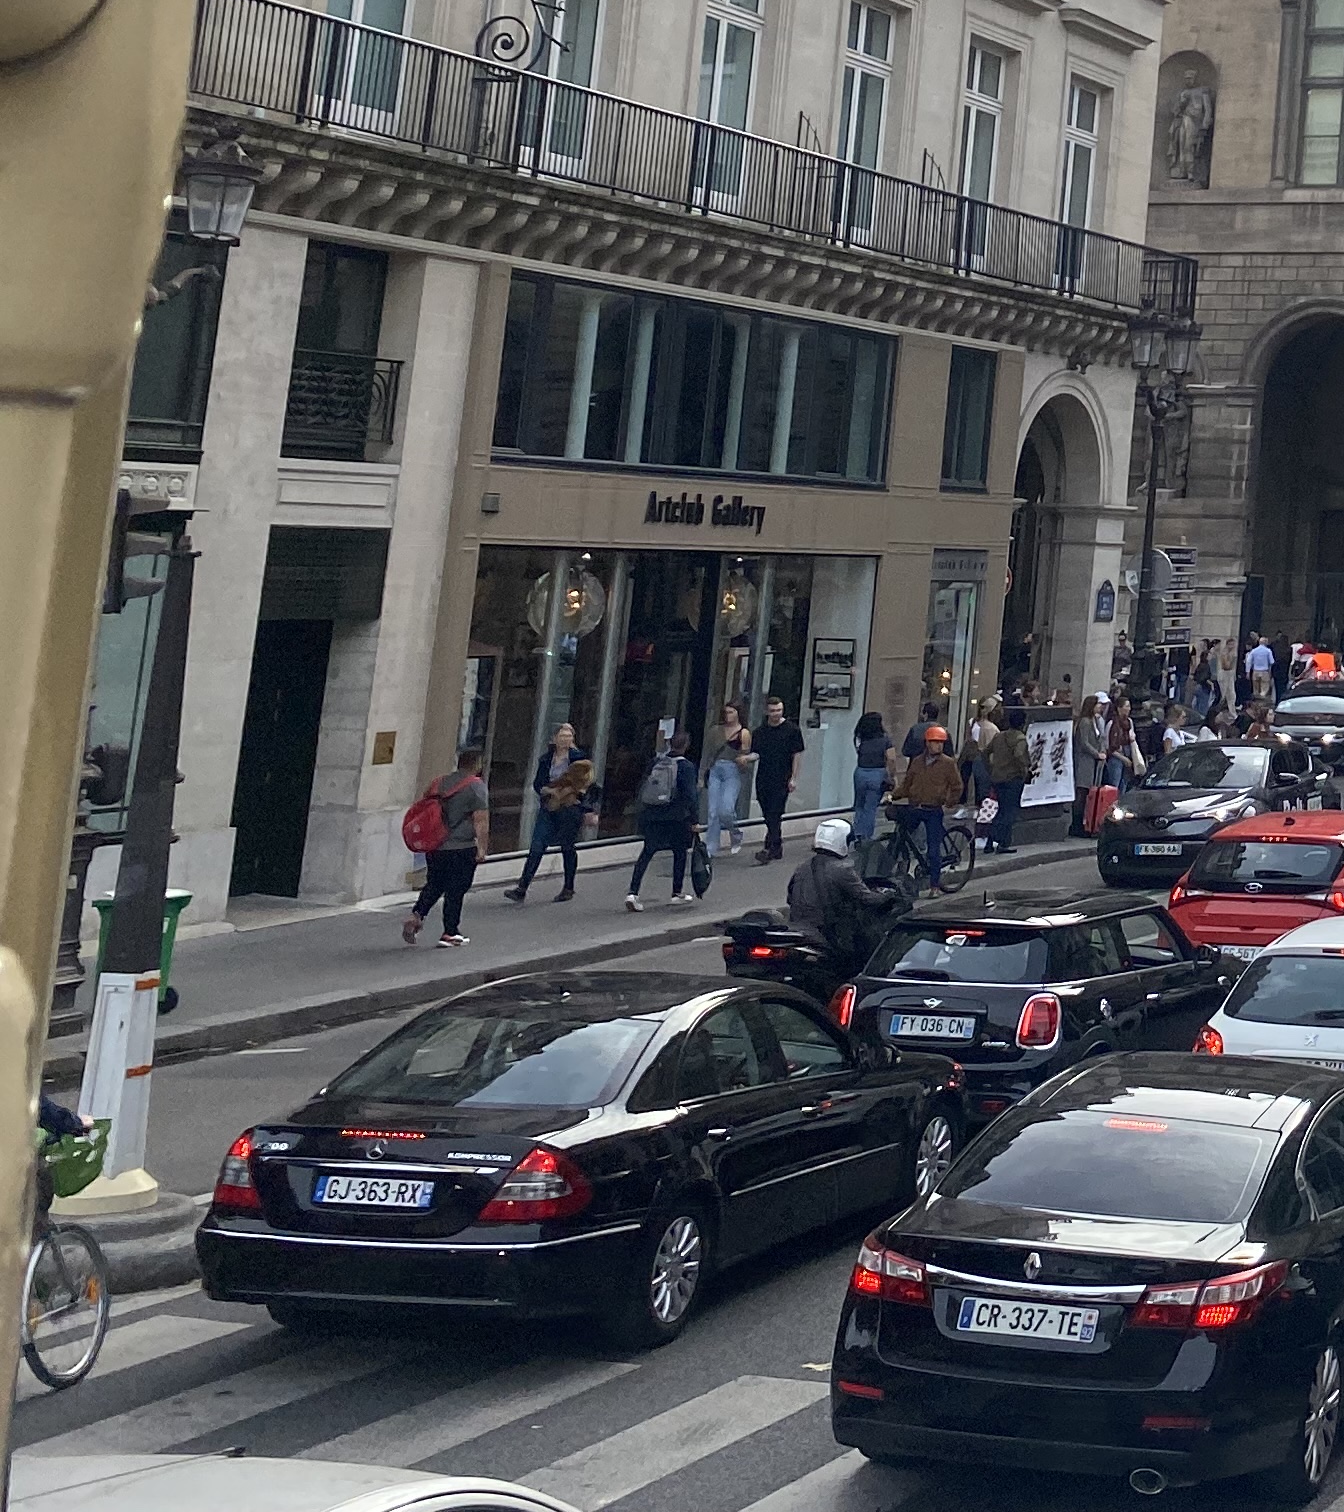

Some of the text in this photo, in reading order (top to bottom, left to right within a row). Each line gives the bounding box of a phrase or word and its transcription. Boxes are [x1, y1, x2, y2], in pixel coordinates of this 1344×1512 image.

[643, 491, 767, 537] Artclub Gallery
[327, 1179, 421, 1204] GJ-363-RX
[975, 1303, 1082, 1336] CR-337-TE
